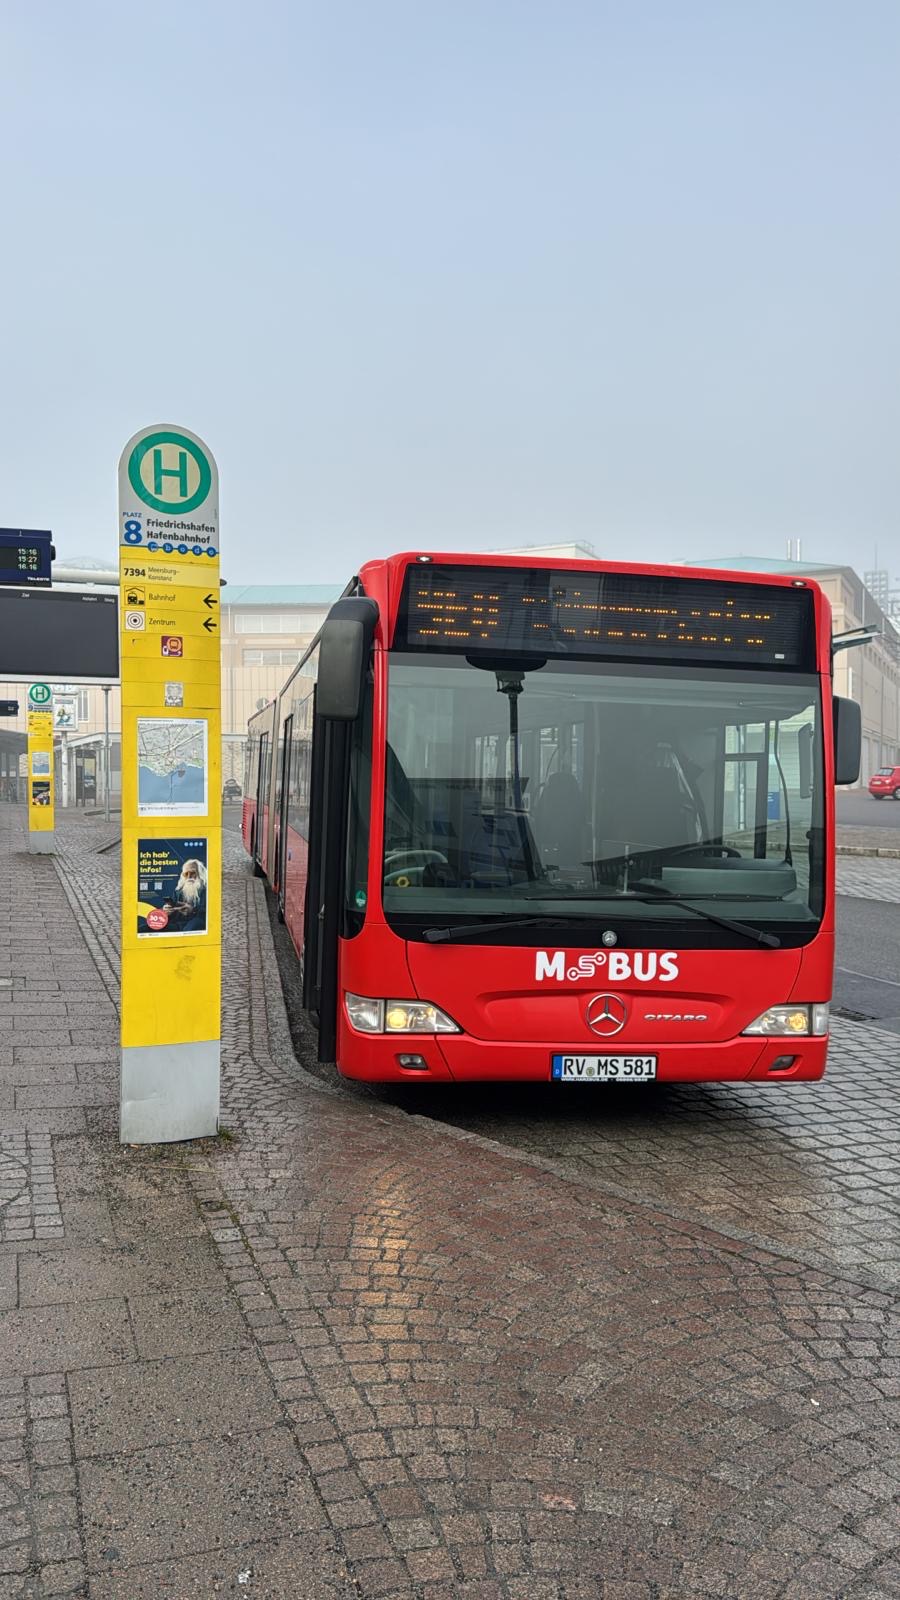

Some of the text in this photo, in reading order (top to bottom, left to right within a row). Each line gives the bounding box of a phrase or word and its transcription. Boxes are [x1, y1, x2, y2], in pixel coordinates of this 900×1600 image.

[153, 448, 188, 498] H
[124, 520, 143, 544] 8
[147, 519, 216, 533] Friedrichshafen
[147, 531, 211, 544] Hafenbahnhof
[124, 568, 146, 577] 7394
[149, 593, 176, 602] Bahnhof
[36, 687, 45, 699] H
[563, 1058, 654, 1076] RV MS 581
